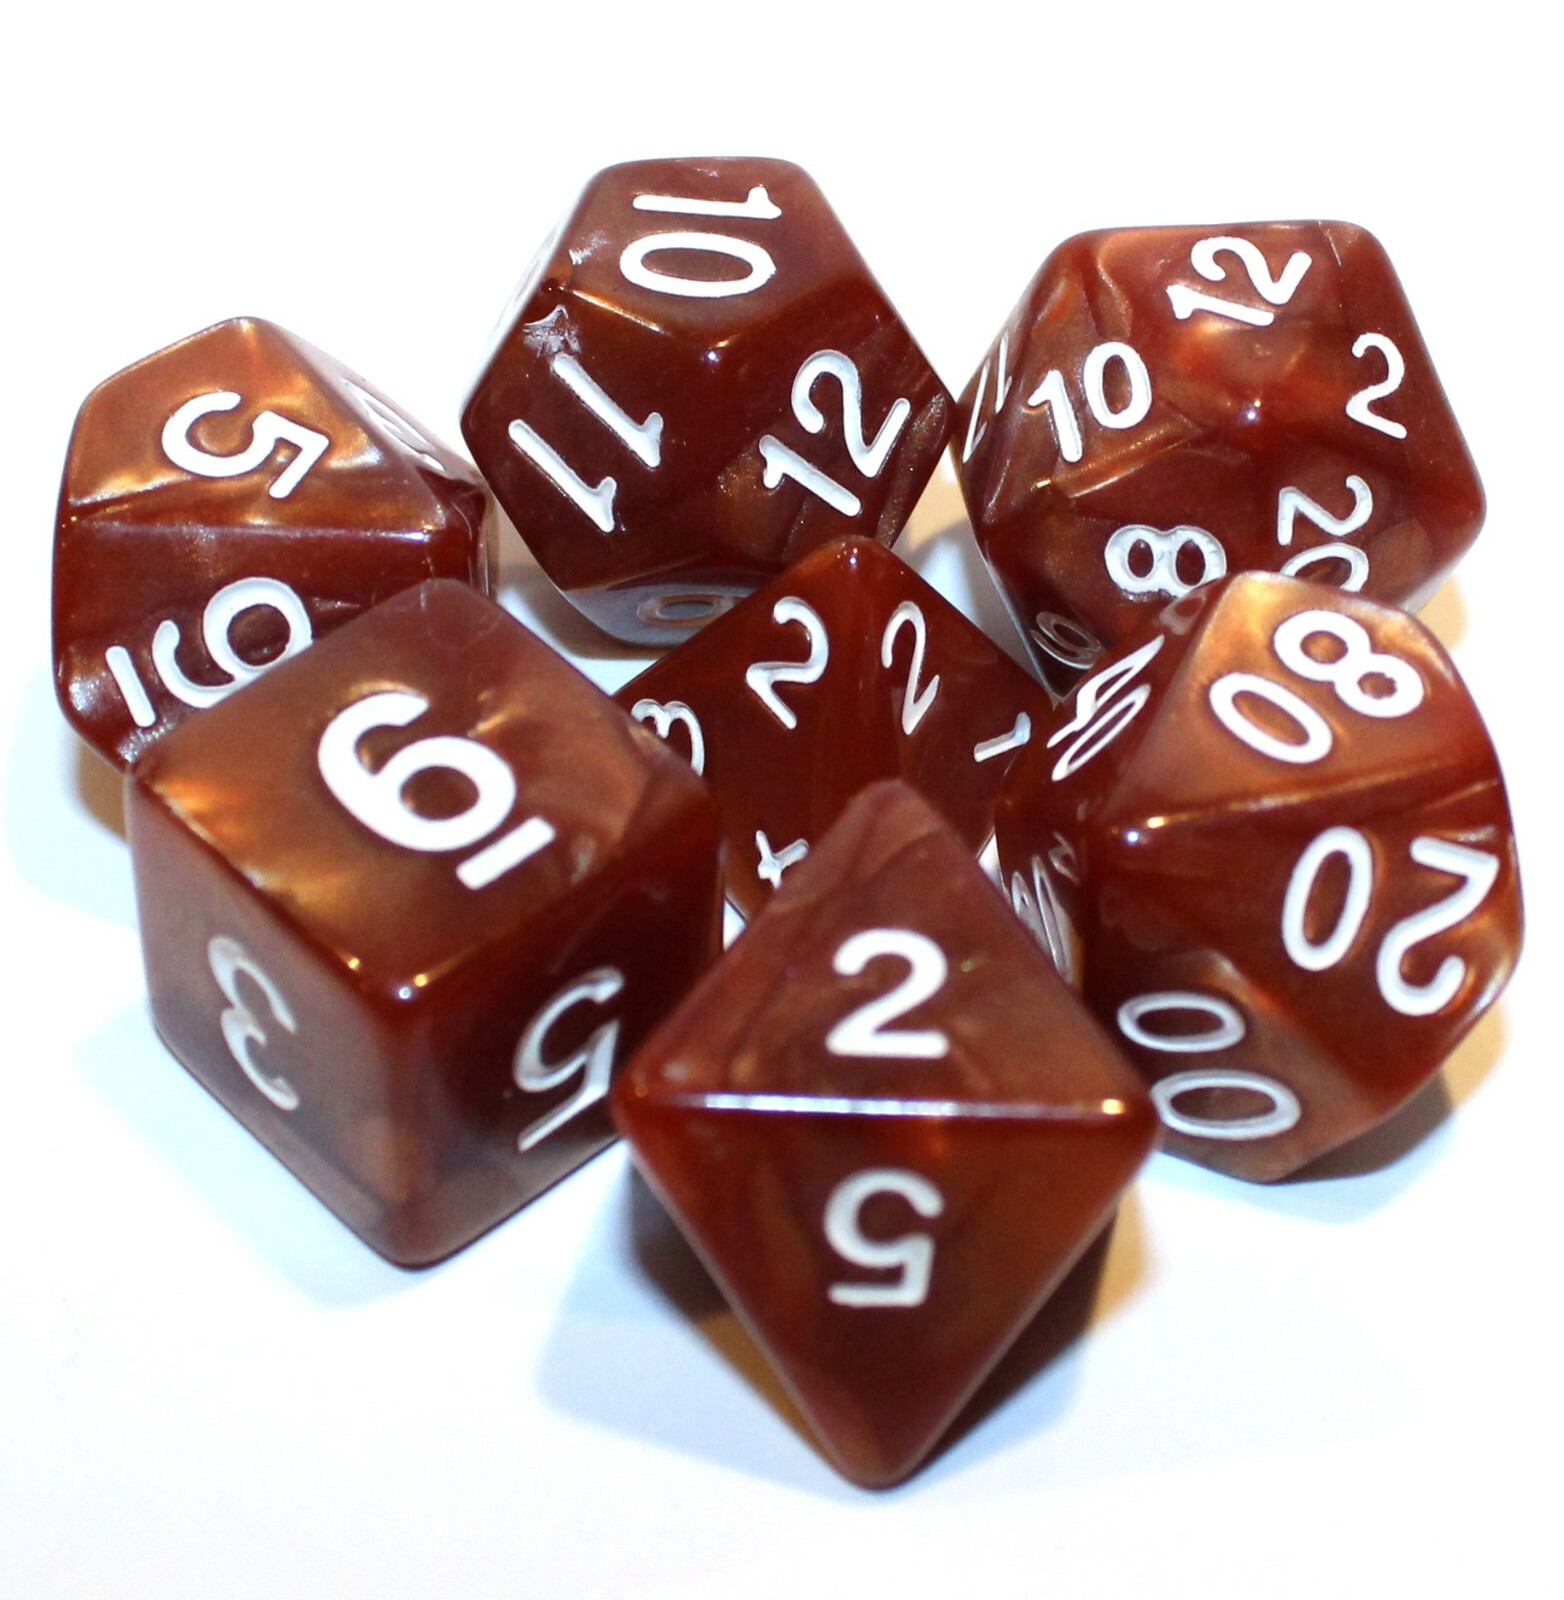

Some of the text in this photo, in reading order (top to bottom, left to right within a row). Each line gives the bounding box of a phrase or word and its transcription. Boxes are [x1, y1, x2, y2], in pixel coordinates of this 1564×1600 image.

[619, 185, 782, 298] 10
[1166, 236, 1312, 327] 12
[162, 390, 330, 499] 5
[507, 352, 664, 533] 11
[757, 349, 911, 517] 12
[1028, 341, 1152, 462] 10
[1345, 332, 1408, 440] 2
[1104, 524, 1228, 598] 8
[1278, 474, 1375, 593] 20
[745, 596, 829, 730] 2
[881, 600, 940, 735] 2
[1046, 633, 1167, 782] 40
[1208, 609, 1425, 764] 80
[317, 691, 556, 891] 6
[1281, 825, 1500, 1017] 20
[207, 936, 299, 1111] 3
[513, 966, 625, 1153] 5
[825, 928, 949, 1058] 2
[1116, 991, 1302, 1140] 00
[823, 1168, 944, 1308] 5
